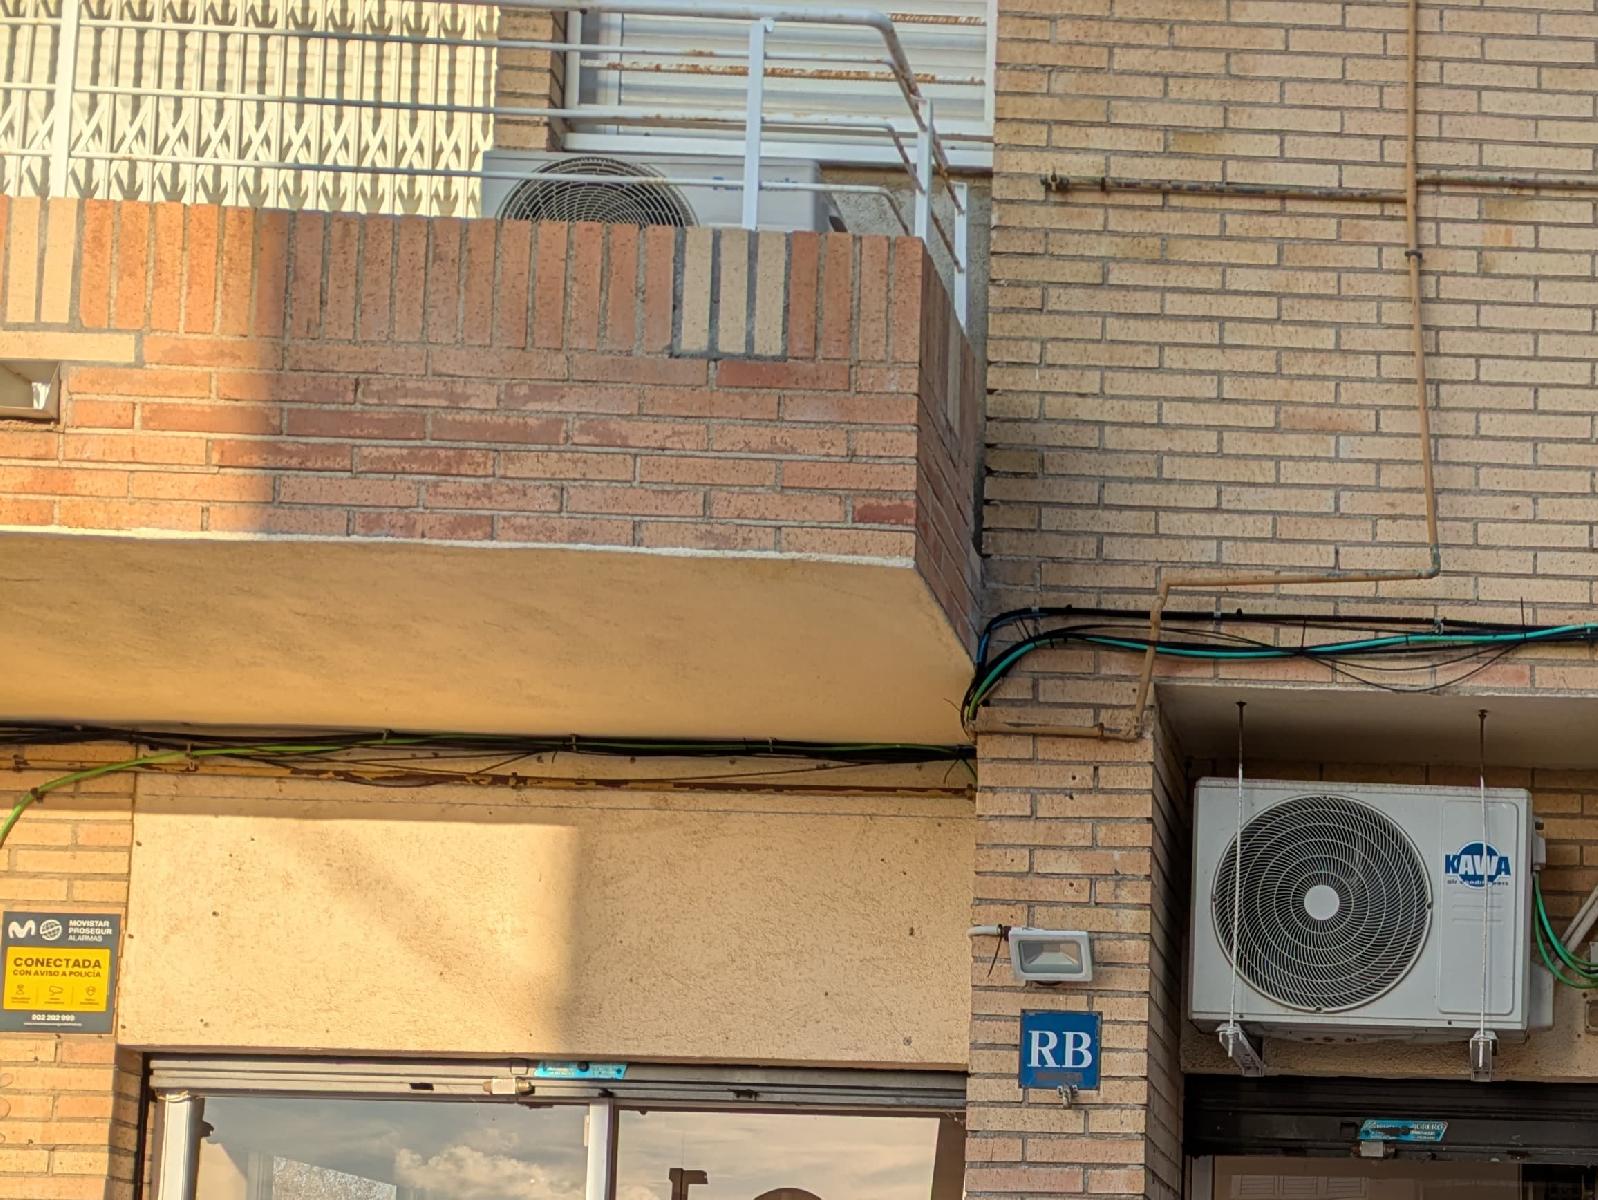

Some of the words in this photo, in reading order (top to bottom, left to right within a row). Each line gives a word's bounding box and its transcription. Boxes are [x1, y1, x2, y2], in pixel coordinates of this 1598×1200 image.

[1445, 854, 1511, 876] KAWA
[13, 957, 102, 969] CONECTADA
[13, 969, 32, 977] CON
[61, 970, 68, 978] A
[1027, 1030, 1093, 1068] RB
